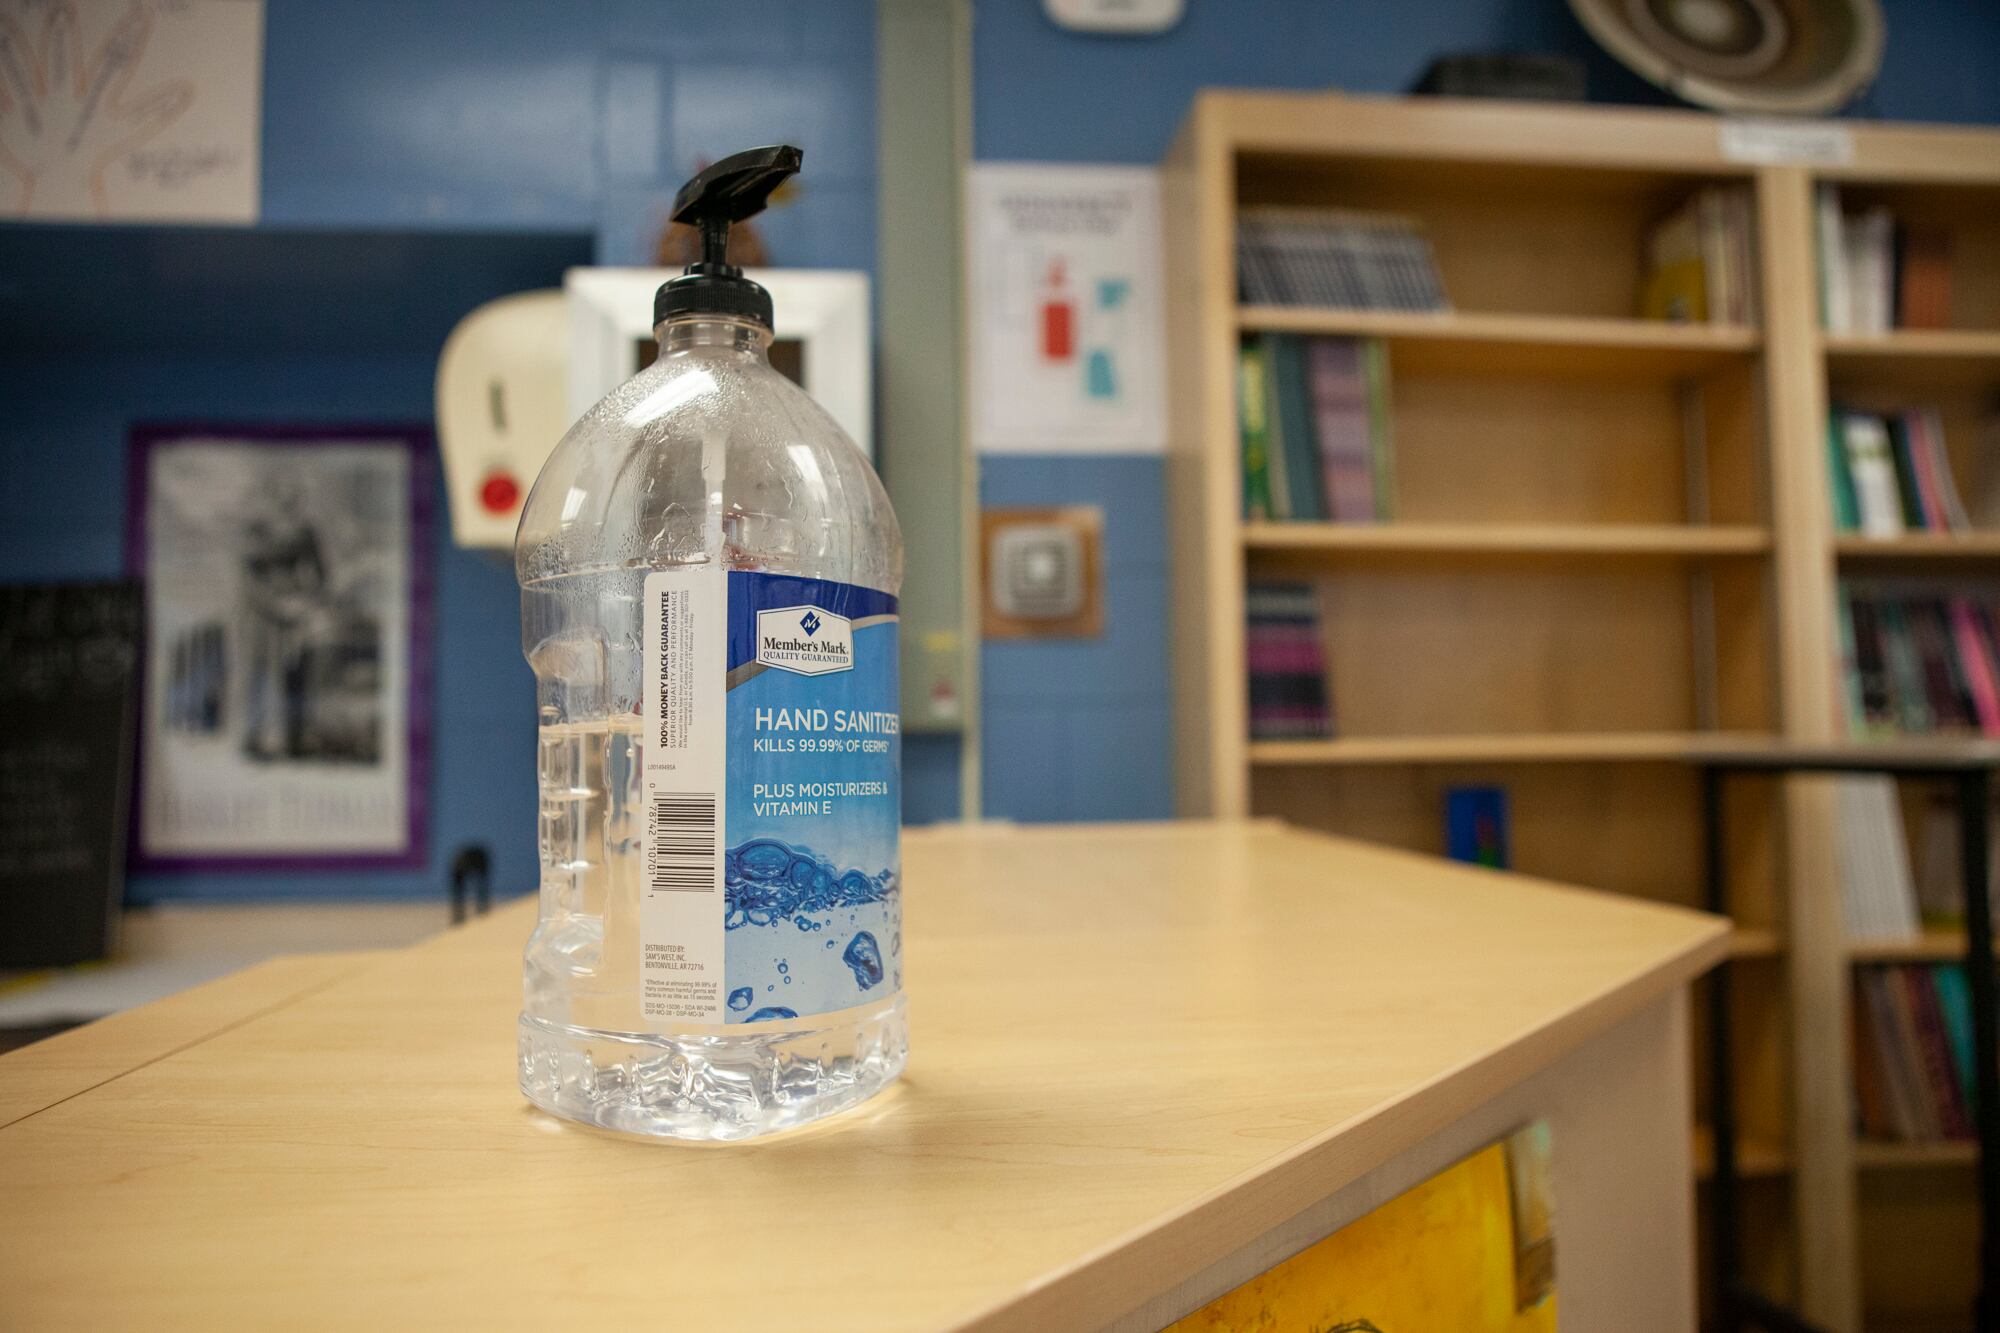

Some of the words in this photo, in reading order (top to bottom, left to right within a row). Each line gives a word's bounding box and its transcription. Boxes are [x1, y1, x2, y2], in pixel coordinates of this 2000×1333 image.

[660, 591, 668, 652] GUARANTEE
[764, 637, 818, 652] Member's
[820, 641, 846, 654] Mark
[660, 654, 668, 680] BACK
[763, 651, 800, 660] QUALITY
[802, 652, 849, 664] GUARANTEED
[660, 682, 668, 719] MONEY
[756, 708, 828, 731] HAND
[660, 720, 668, 748] 100%
[754, 739, 795, 752] KILLS
[800, 739, 844, 752] 99.99%
[846, 740, 860, 752] OF
[754, 784, 794, 798] PLUS
[800, 782, 882, 797] MOISTURIZERS
[754, 801, 818, 817] VITAMIN
[822, 801, 832, 814] E
[648, 846, 656, 876] 10701
[645, 944, 676, 952] DISTRIBUTED
